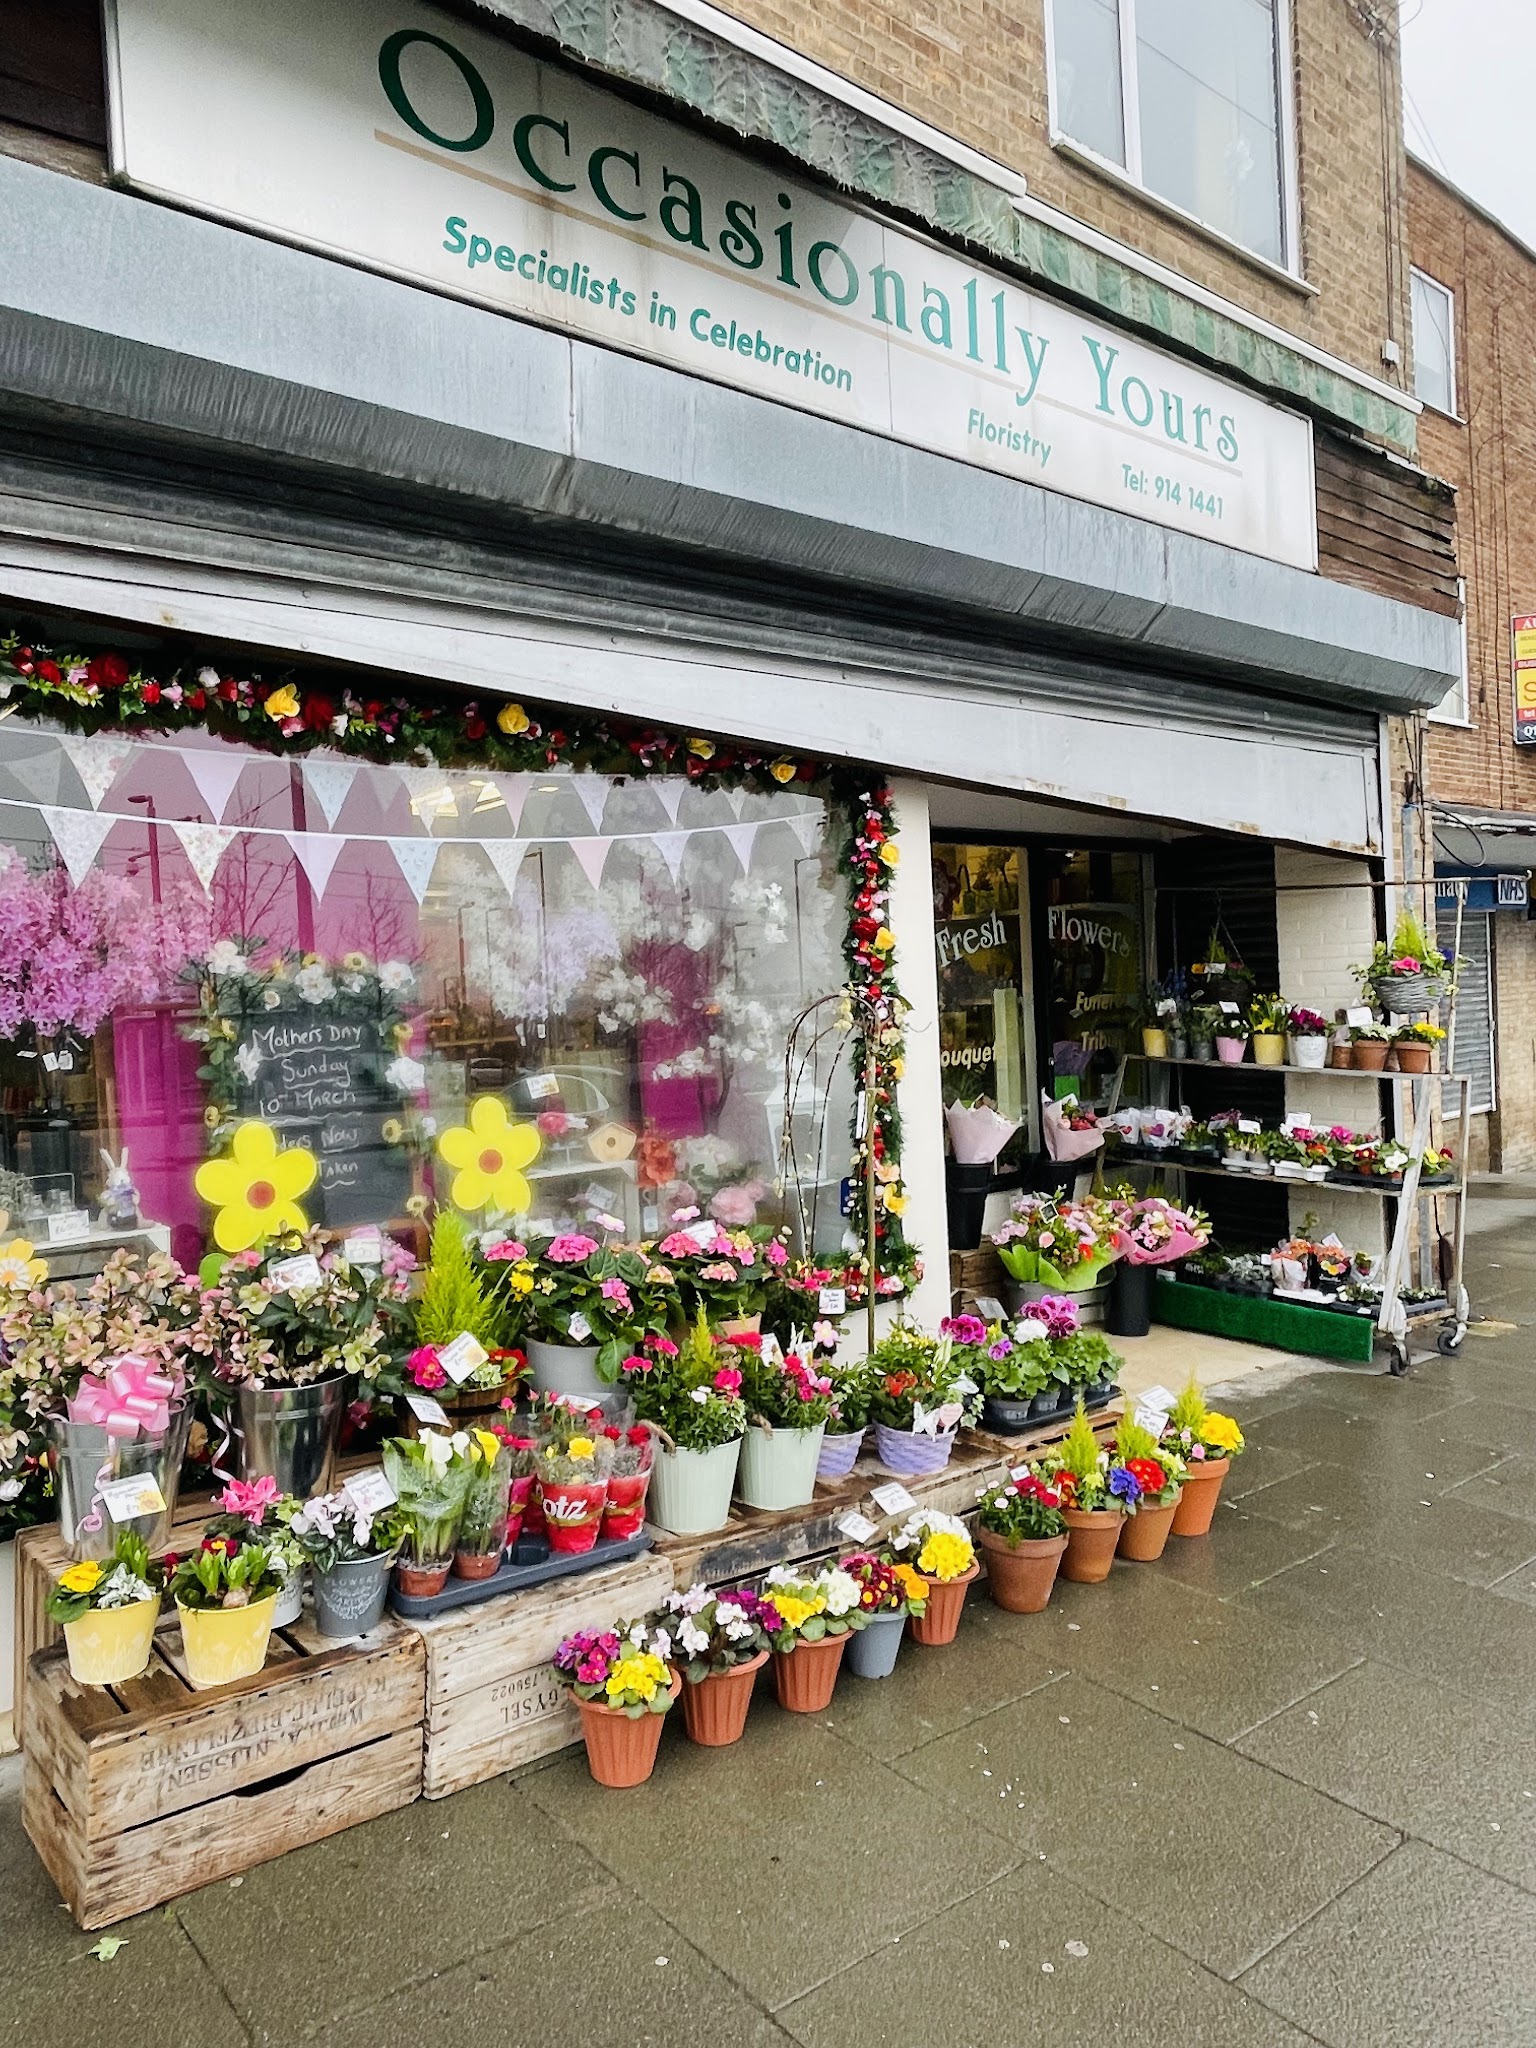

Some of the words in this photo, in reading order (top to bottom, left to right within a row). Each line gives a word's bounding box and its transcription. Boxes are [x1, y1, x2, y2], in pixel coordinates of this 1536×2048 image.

[378, 29, 1050, 406] Occasionally
[1082, 335, 1239, 462] Yours
[442, 217, 635, 316] Specialists
[650, 291, 676, 331] in
[690, 308, 852, 392] Celebration
[968, 408, 1052, 468] Floristry
[1122, 464, 1149, 495] Tel:
[1156, 477, 1182, 505] 914
[1188, 487, 1223, 519] 1441
[1501, 880, 1525, 901] NHS
[935, 908, 1007, 968] Fresh
[1048, 905, 1130, 957] Flowers
[281, 1054, 351, 1087] Sunday
[321, 1125, 358, 1147] Now
[500, 1688, 558, 1724] GYSEL
